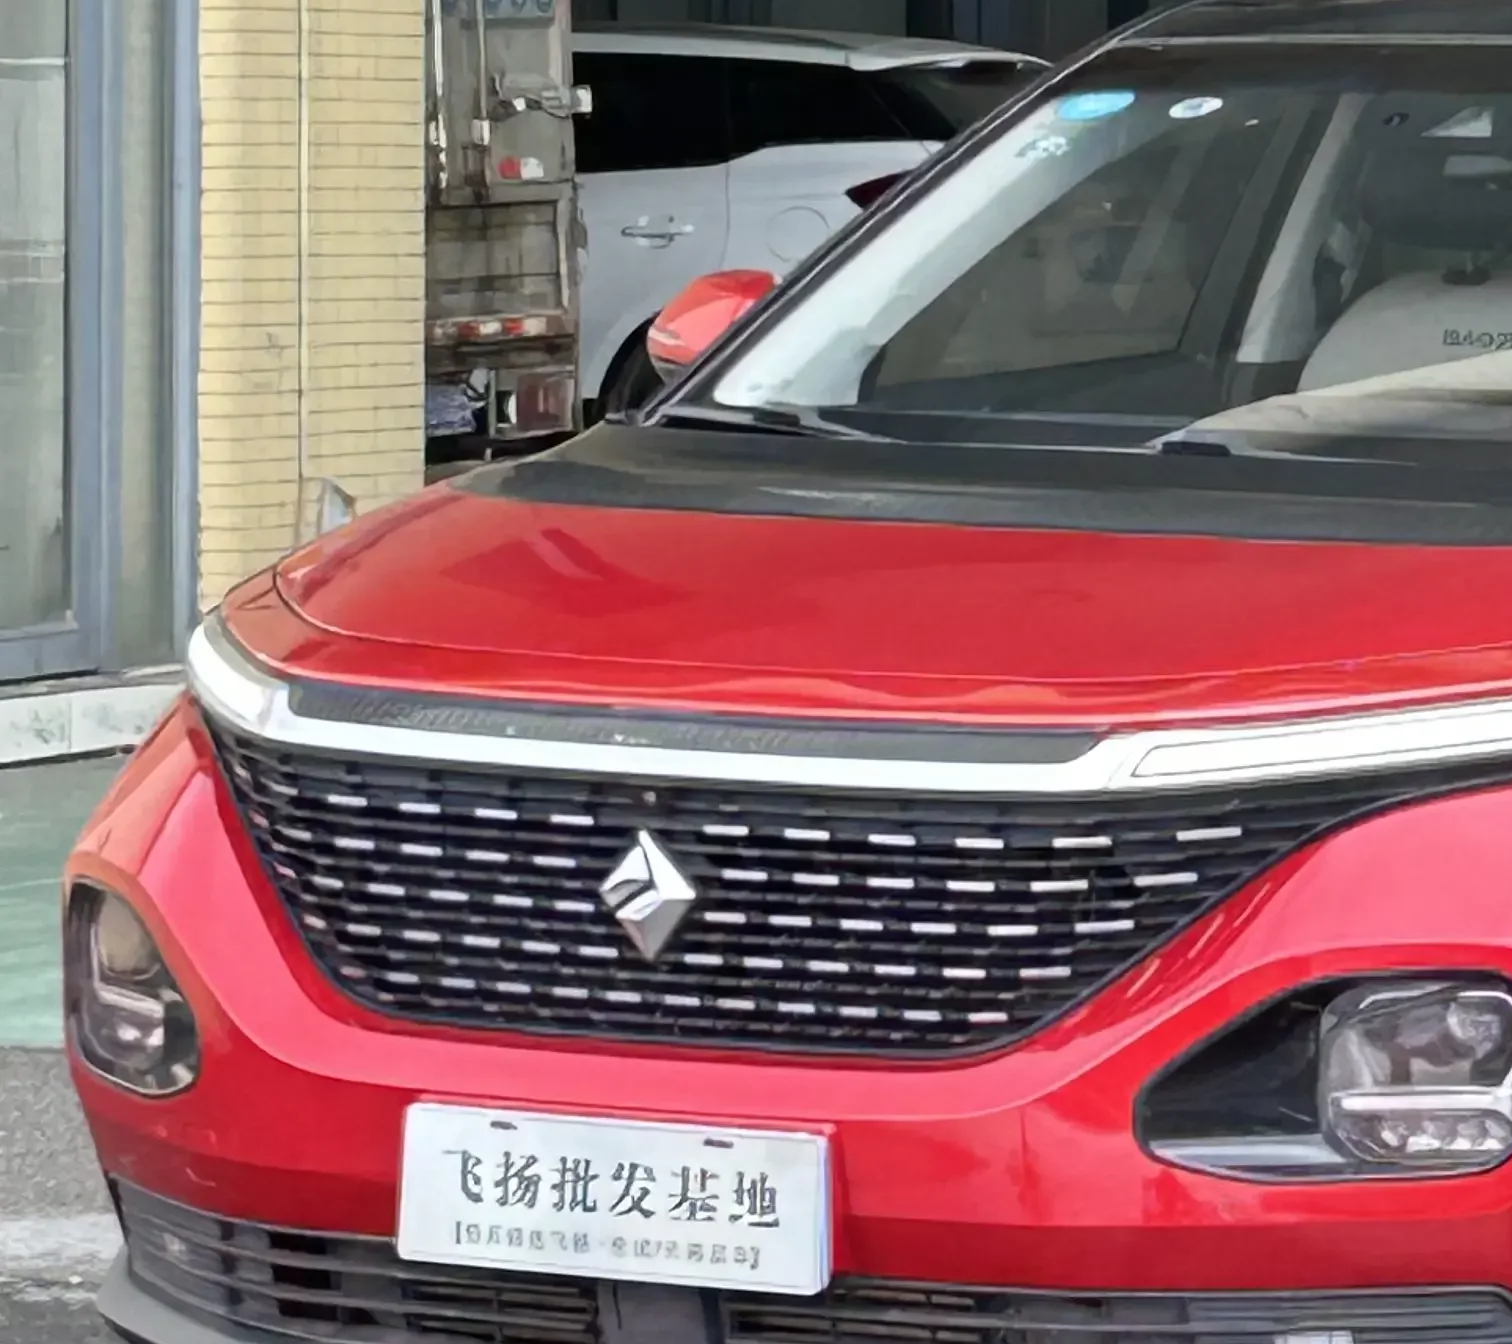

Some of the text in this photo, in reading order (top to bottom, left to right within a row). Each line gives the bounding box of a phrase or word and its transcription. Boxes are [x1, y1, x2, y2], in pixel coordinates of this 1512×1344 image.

[442, 1149, 781, 1229] 飞扬批发基地
